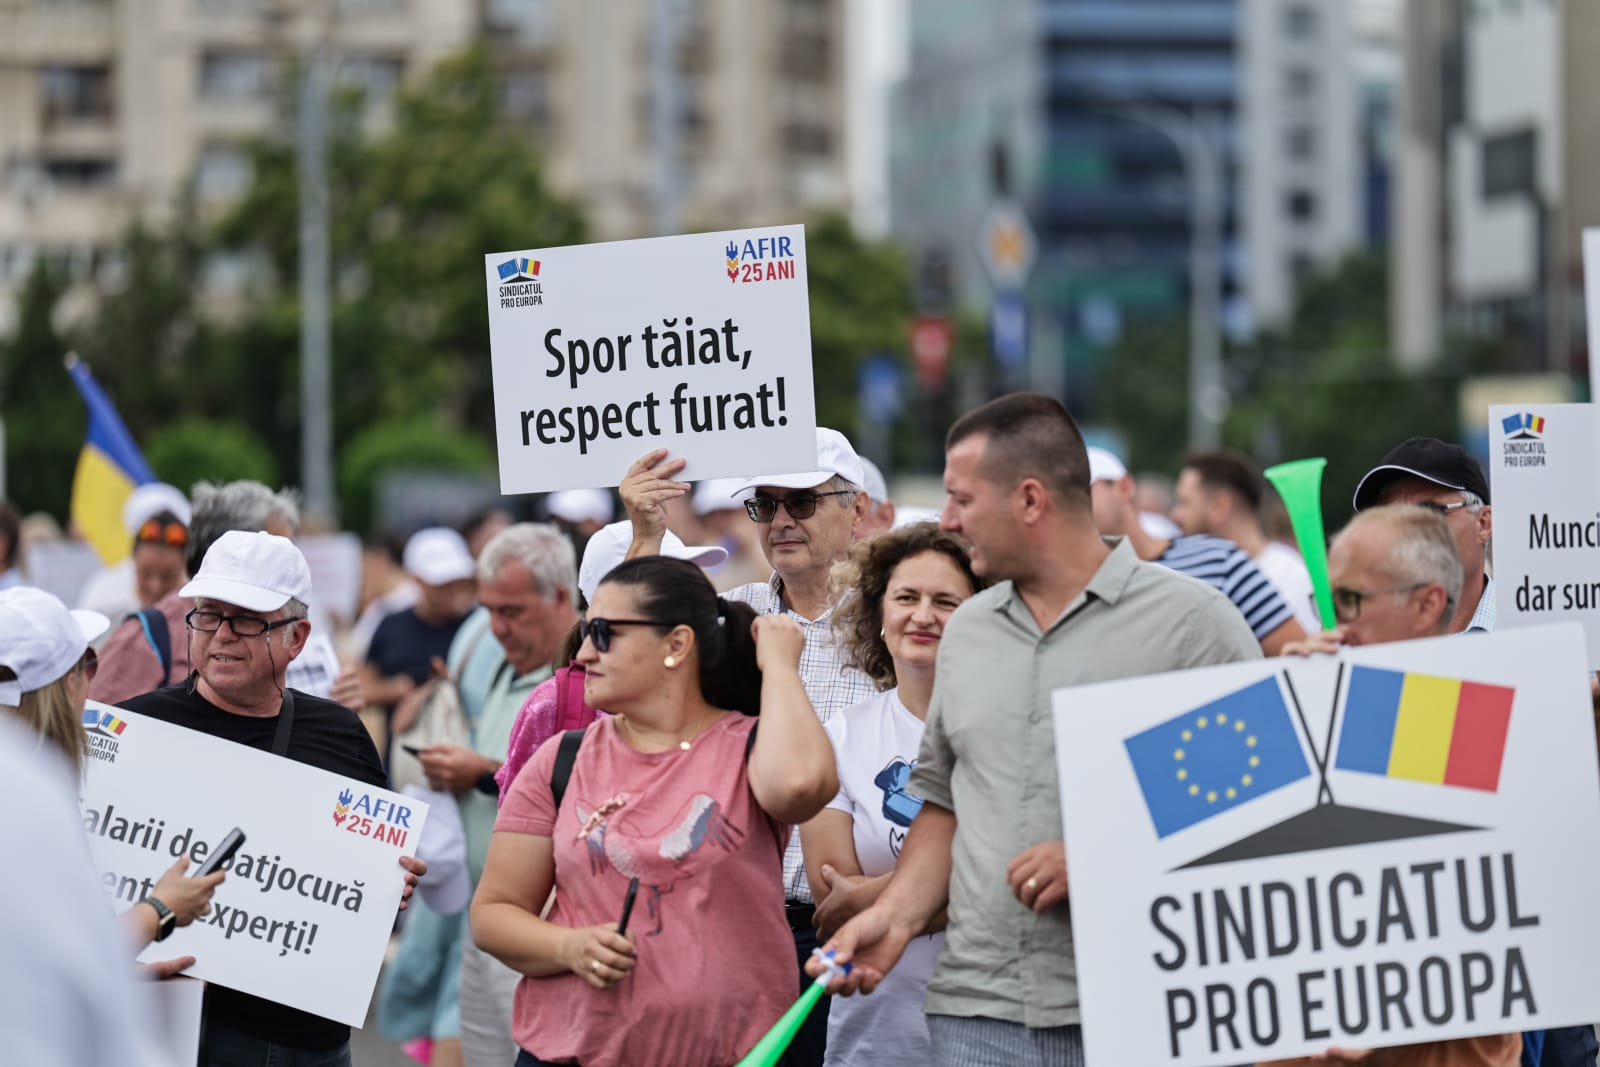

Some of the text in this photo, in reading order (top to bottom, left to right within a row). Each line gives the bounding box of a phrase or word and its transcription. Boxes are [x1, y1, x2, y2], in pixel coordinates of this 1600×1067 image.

[741, 236, 794, 261] AFIR
[741, 260, 795, 283] 25 ANI
[499, 283, 543, 298] SINDICATUL
[501, 295, 543, 309] PRO EUROPA
[544, 317, 752, 389] Spor tăiat,
[520, 376, 788, 455] respect furat!
[1503, 442, 1546, 455] SINDICATUL
[1504, 455, 1546, 468] PRO EUROPA
[1515, 574, 1556, 612] dar
[87, 735, 119, 754] ICATUL
[88, 747, 115, 764] UROPA
[352, 793, 410, 829] AFIR
[80, 799, 165, 852] alarii
[169, 827, 209, 865] de
[346, 814, 408, 848] 25 ANI
[1150, 852, 1541, 971] SINDICATUL
[194, 902, 319, 957] xperți!
[1166, 946, 1538, 1058] PRO EUROPA
